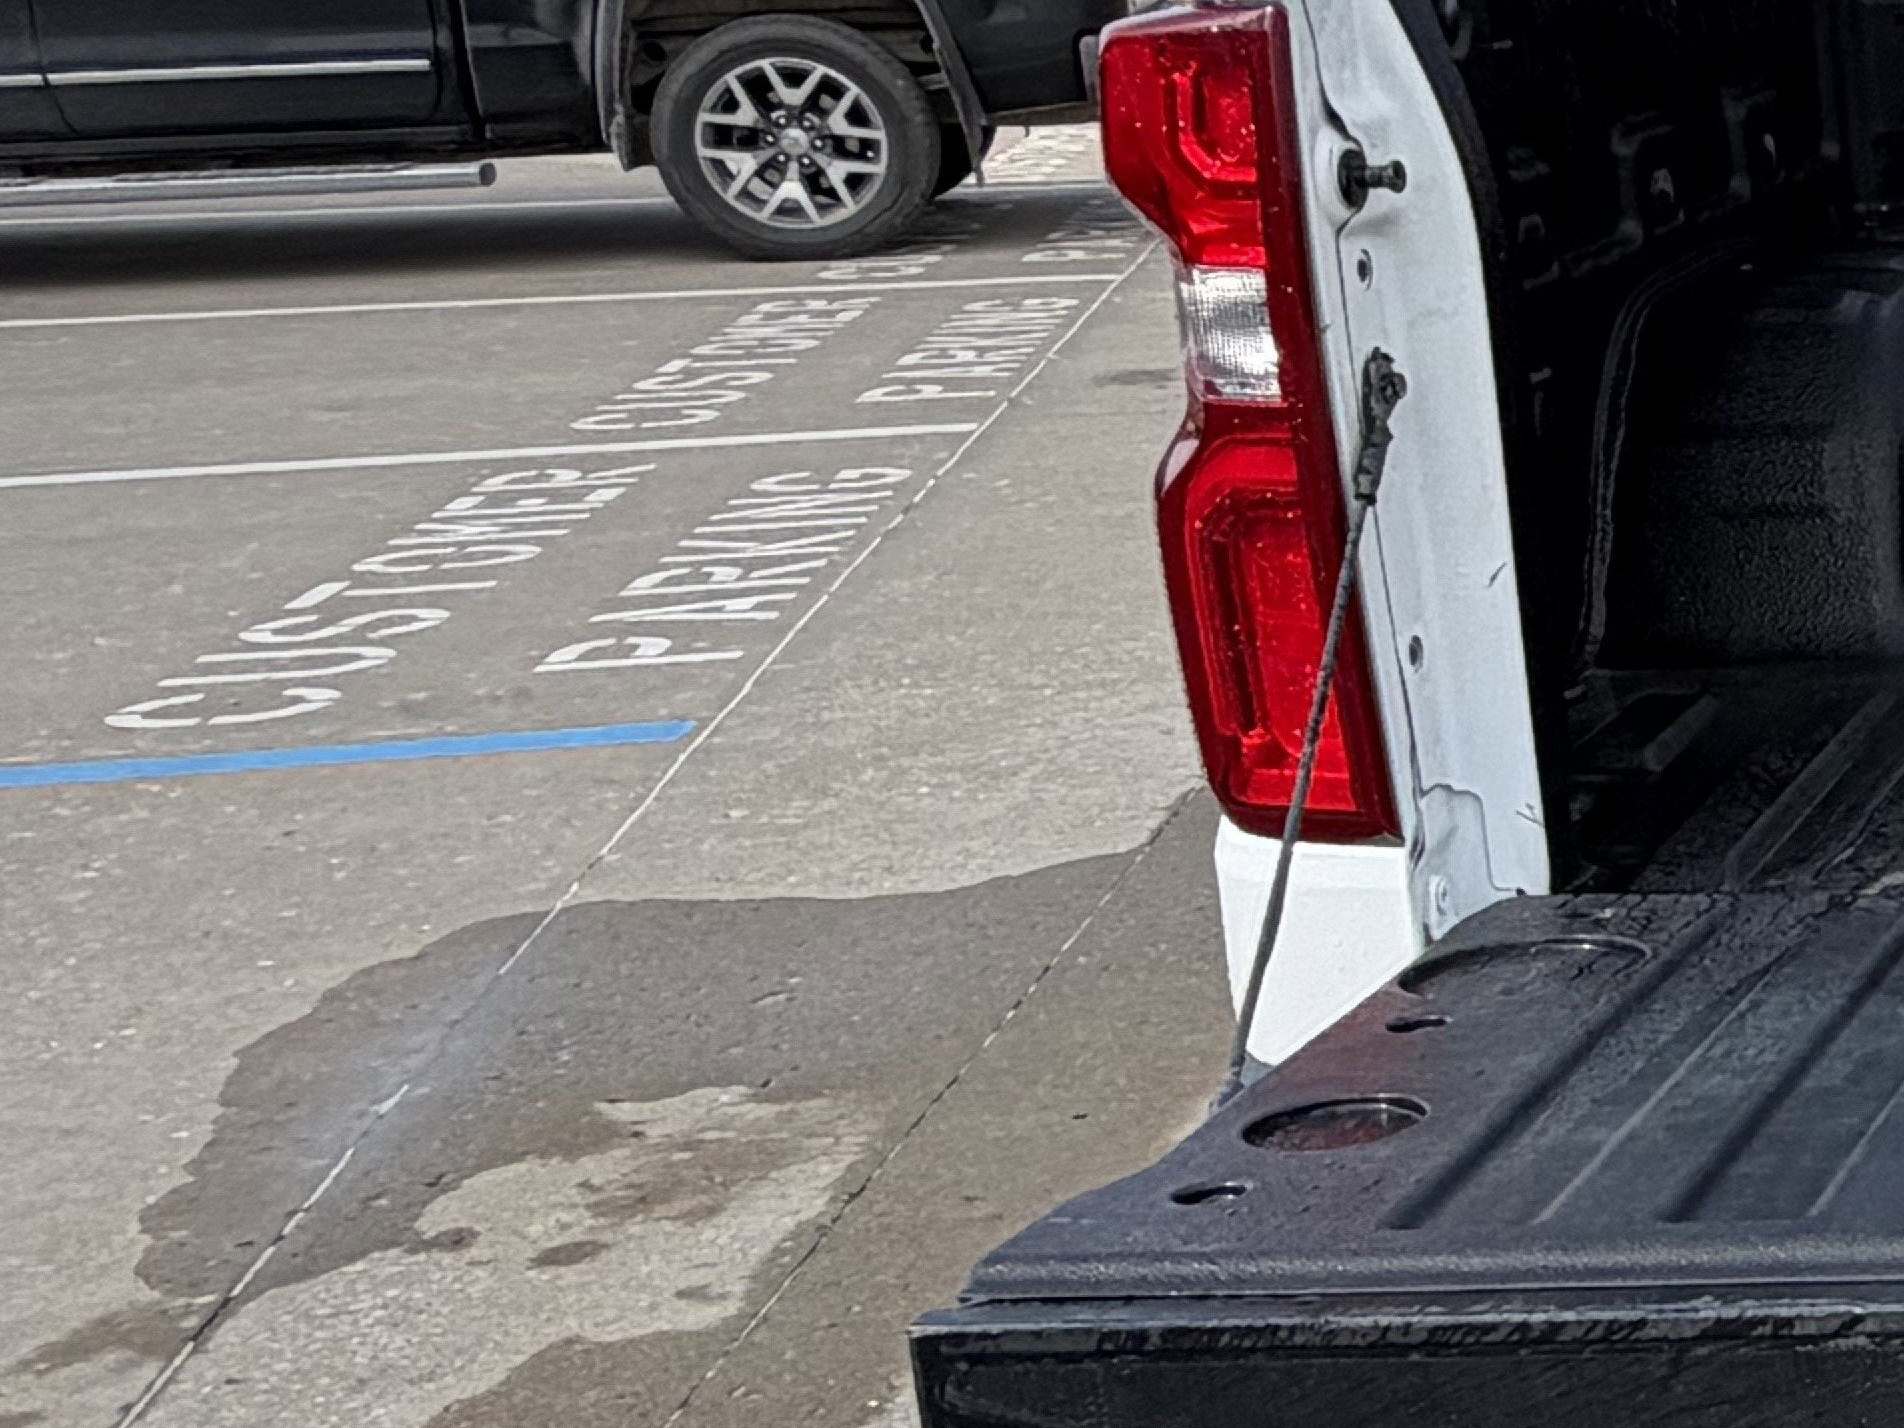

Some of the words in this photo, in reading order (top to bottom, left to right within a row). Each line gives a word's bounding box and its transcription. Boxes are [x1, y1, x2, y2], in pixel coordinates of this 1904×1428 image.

[569, 296, 883, 430] CUSTOMER
[854, 296, 1080, 404] PARKING
[103, 462, 658, 729] CUSTOMER
[532, 466, 914, 673] PARKING
